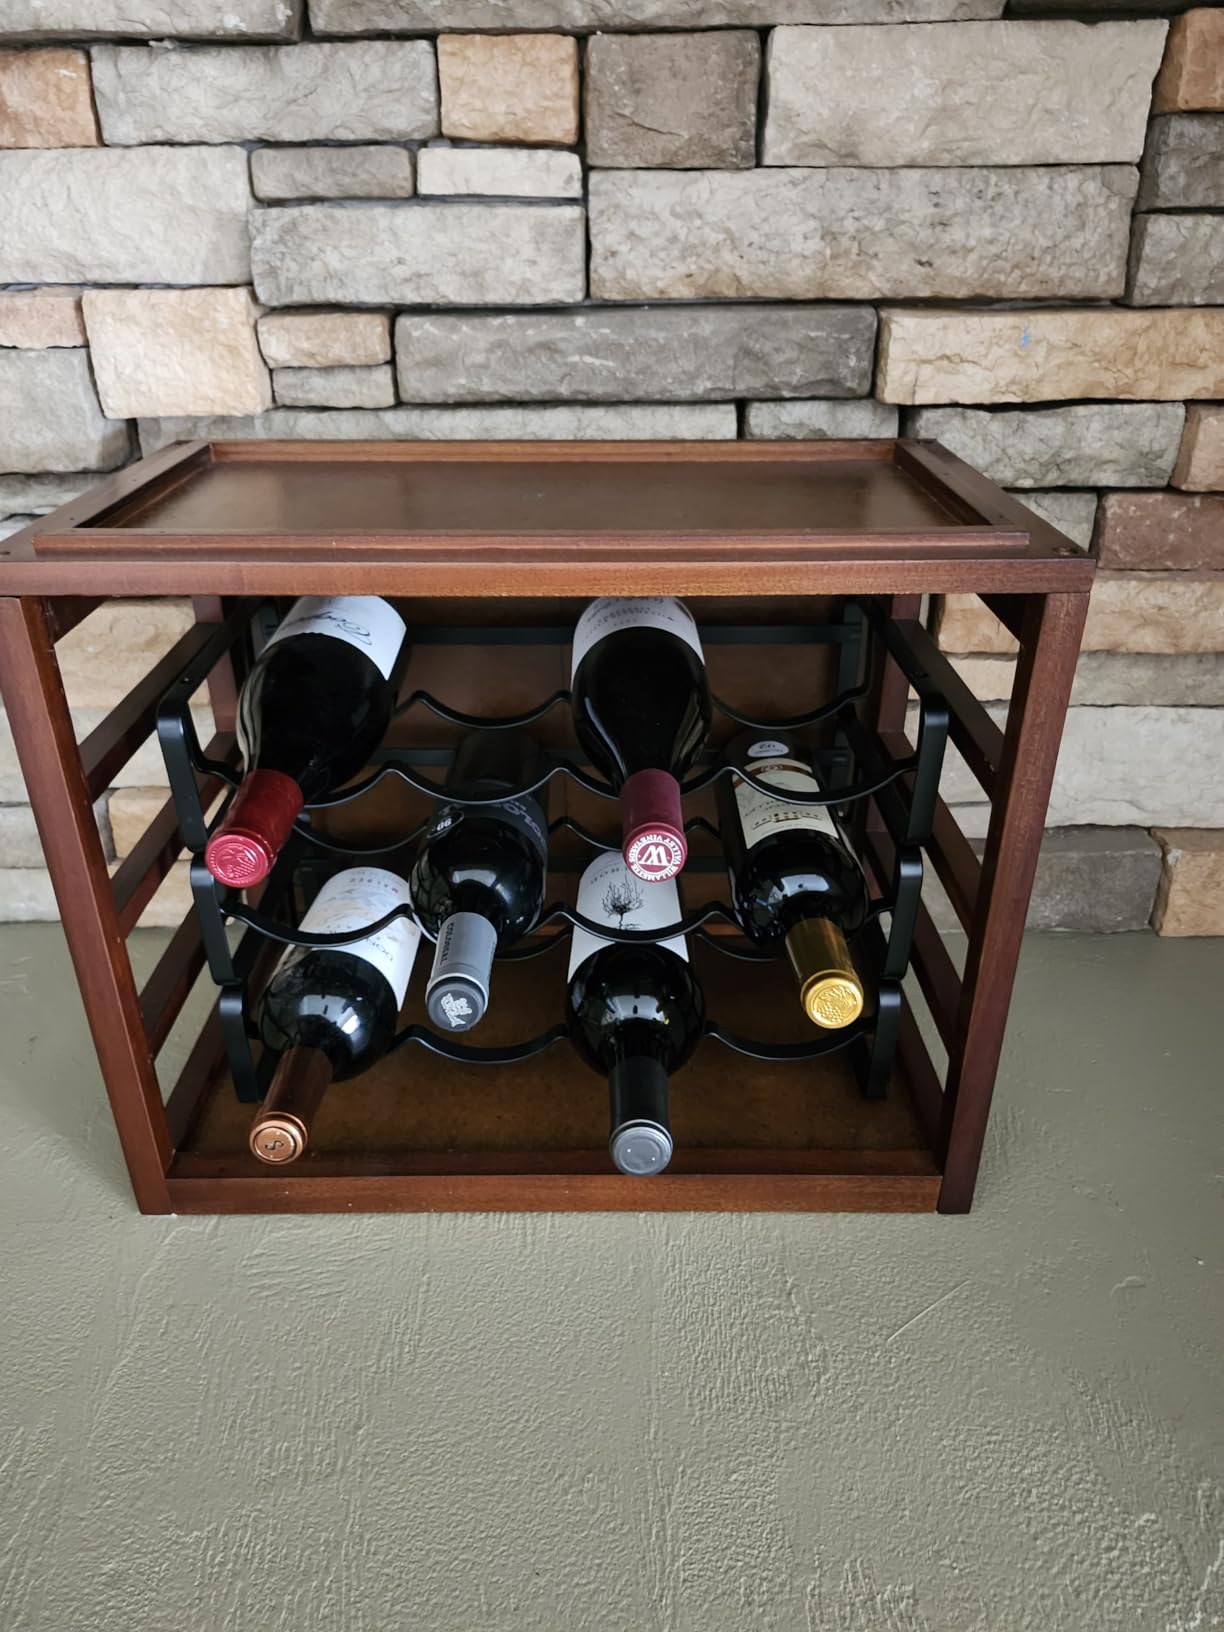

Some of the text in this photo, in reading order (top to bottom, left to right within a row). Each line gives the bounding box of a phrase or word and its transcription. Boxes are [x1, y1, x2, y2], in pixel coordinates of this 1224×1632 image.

[629, 834, 663, 862] VINEYARDS
[638, 845, 671, 866] W
[664, 837, 682, 865] VALLEY
[630, 862, 679, 882] WILLAMETTE
